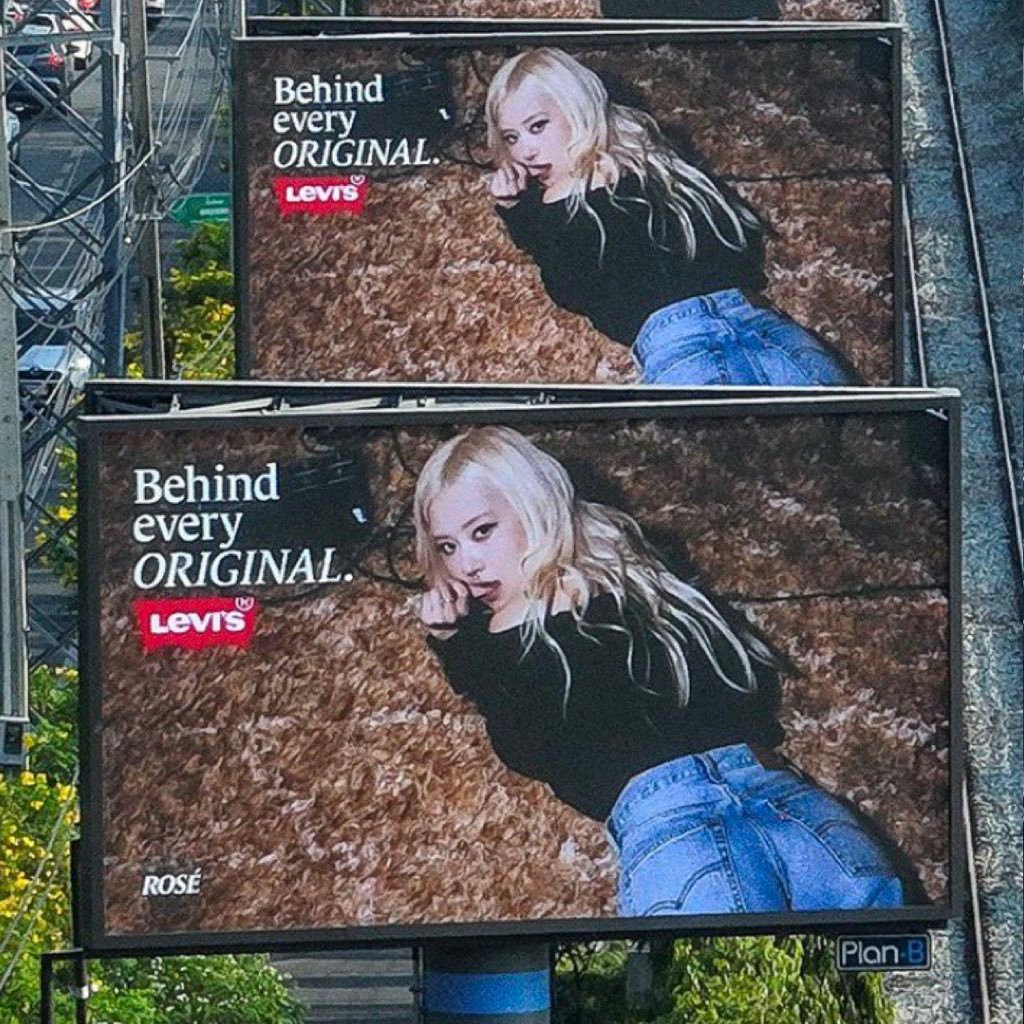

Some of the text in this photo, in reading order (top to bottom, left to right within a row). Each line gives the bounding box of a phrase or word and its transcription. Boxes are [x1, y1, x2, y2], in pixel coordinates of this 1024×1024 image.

[274, 74, 385, 105] Behind
[273, 110, 357, 138] every
[273, 137, 441, 169] ORIGINAL.
[133, 462, 281, 505] Behind
[132, 510, 243, 549] every
[132, 547, 354, 590] ORIGINAL.
[149, 608, 247, 635] Levi's
[141, 867, 203, 897] ROSÉ
